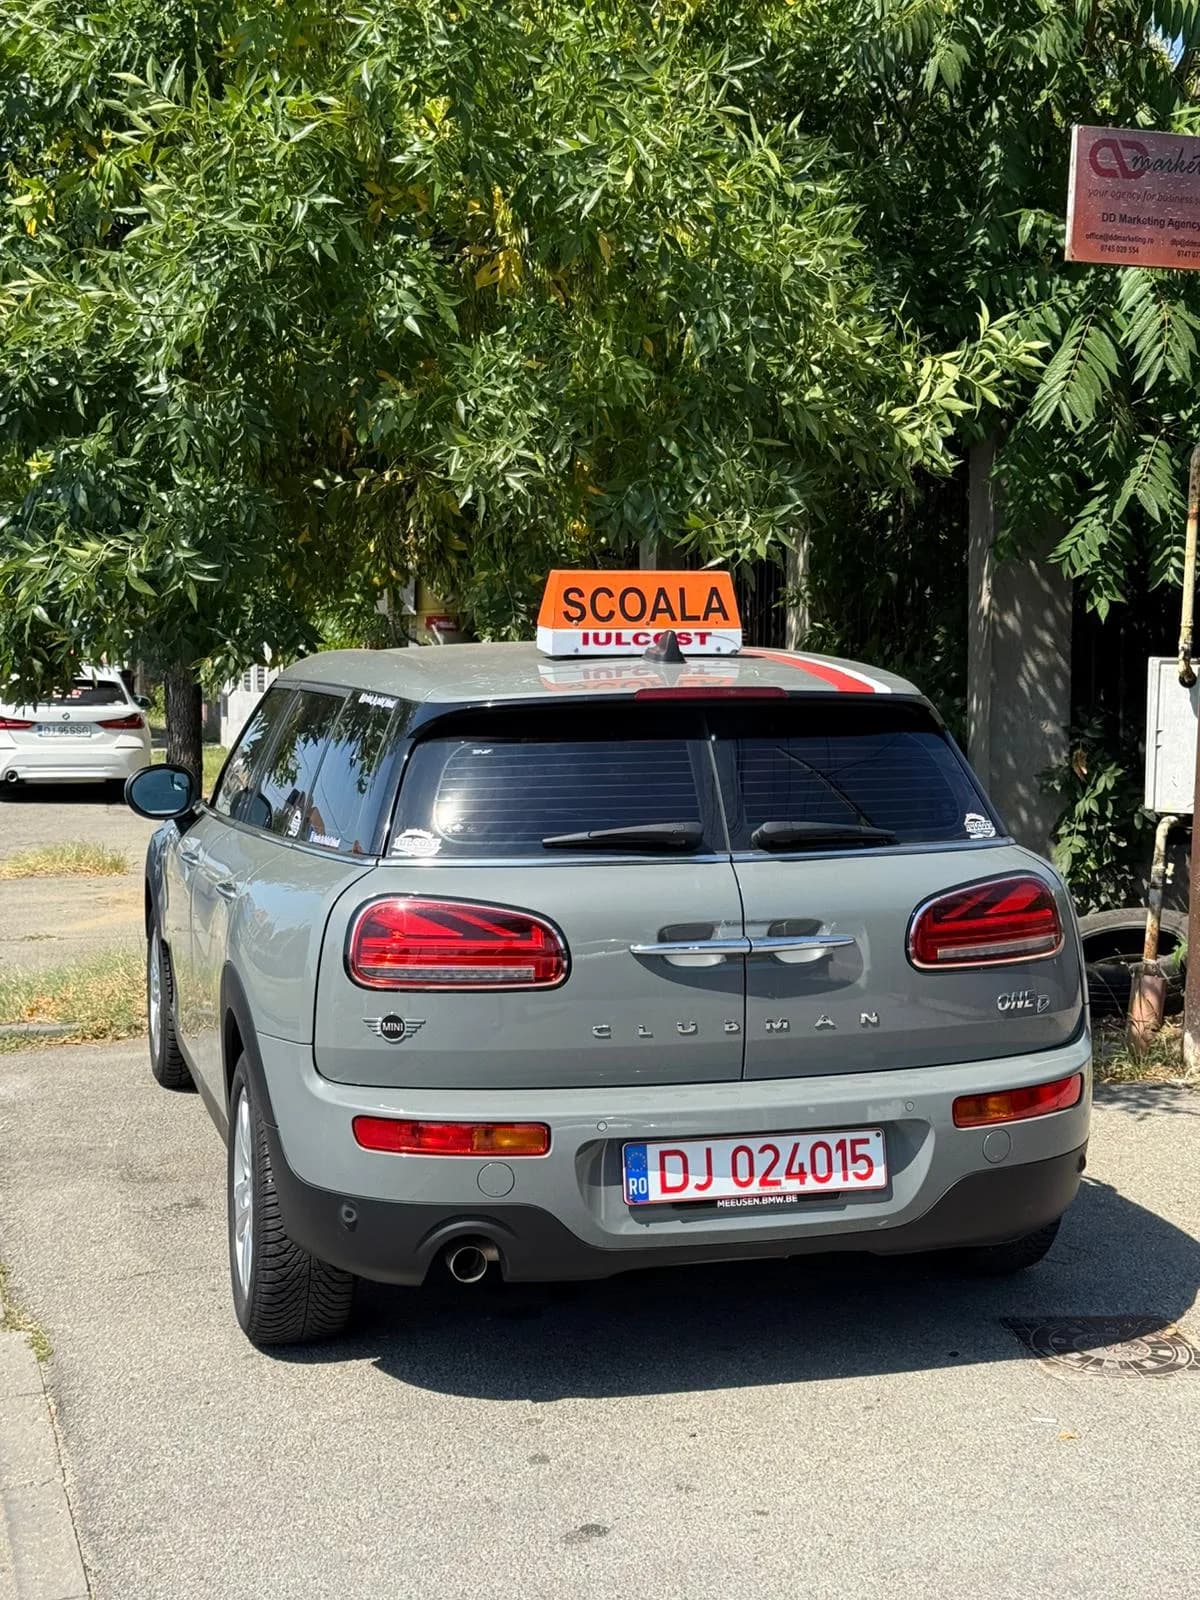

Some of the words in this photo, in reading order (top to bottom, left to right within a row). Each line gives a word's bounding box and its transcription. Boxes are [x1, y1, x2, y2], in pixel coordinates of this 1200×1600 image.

[1088, 189, 1108, 199] your
[1110, 190, 1141, 201] agency
[1142, 190, 1156, 202] for
[1101, 212, 1116, 223] DD
[1118, 214, 1166, 229] Marketing
[1167, 217, 1200, 231] Agency
[562, 587, 730, 623] SCOALA
[996, 989, 1035, 1011] ONE
[382, 1022, 404, 1032] MINI
[591, 1011, 881, 1038] CLUBMAN
[658, 1147, 714, 1195] DJ
[730, 1138, 875, 1189] 024015
[628, 1176, 648, 1196] RO
[716, 1194, 799, 1209] MEEUSEN.BMW.BE
